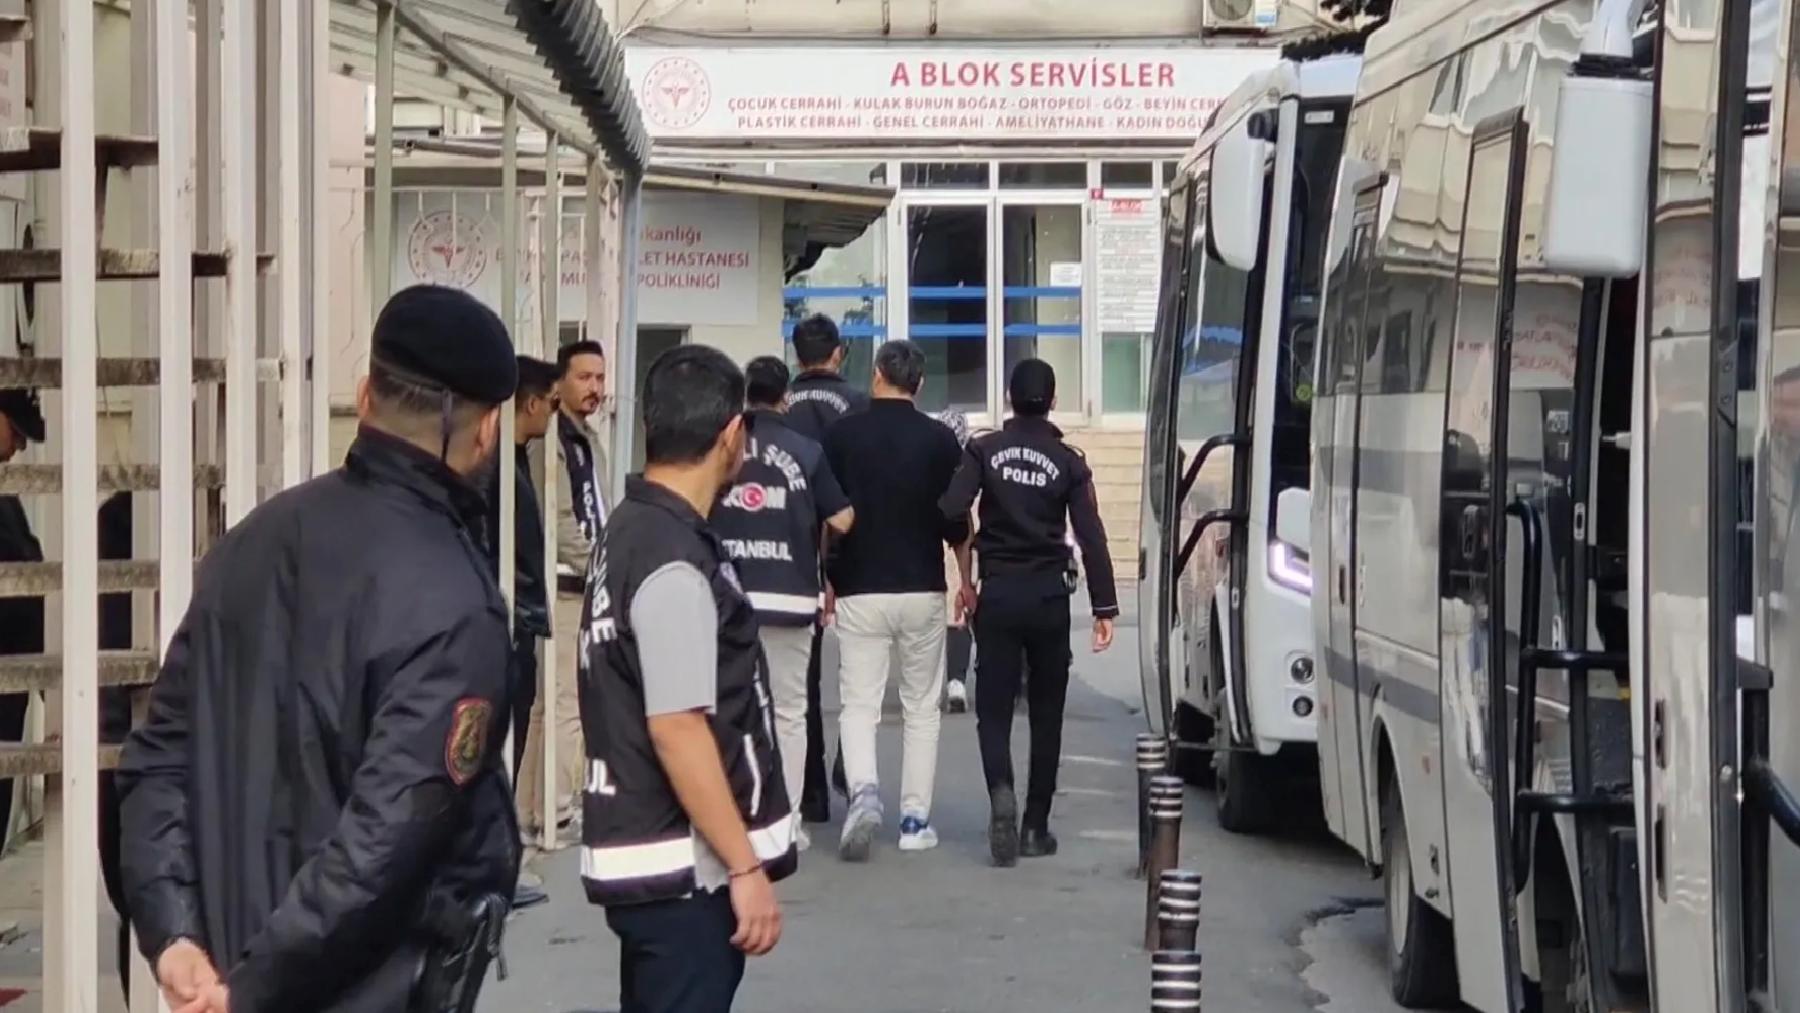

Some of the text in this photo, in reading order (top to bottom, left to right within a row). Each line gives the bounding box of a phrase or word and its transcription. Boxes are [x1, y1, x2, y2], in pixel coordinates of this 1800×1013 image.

[890, 56, 1175, 88] A BLOK SERVİSLER
[728, 96, 777, 113] ÇOCUK
[780, 95, 842, 110] CERRAHİ
[853, 96, 902, 110] KULAK
[904, 96, 954, 110] BURUN
[957, 94, 1007, 110] BOĞAZ
[1018, 95, 1091, 110] ORTOPEDİ
[1102, 94, 1133, 110] GÖZ
[738, 114, 796, 129] PLASTİK
[799, 114, 862, 129] CERRAHİ
[872, 114, 918, 129] GENEL
[921, 114, 984, 129] CERRAHİ
[995, 114, 1104, 130] AMELİYATHANE
[1116, 115, 1162, 130] KADIN
[641, 225, 702, 247] kanlığı
[1022, 447, 1060, 481] KUVVET
[721, 539, 793, 562] TANBUL
